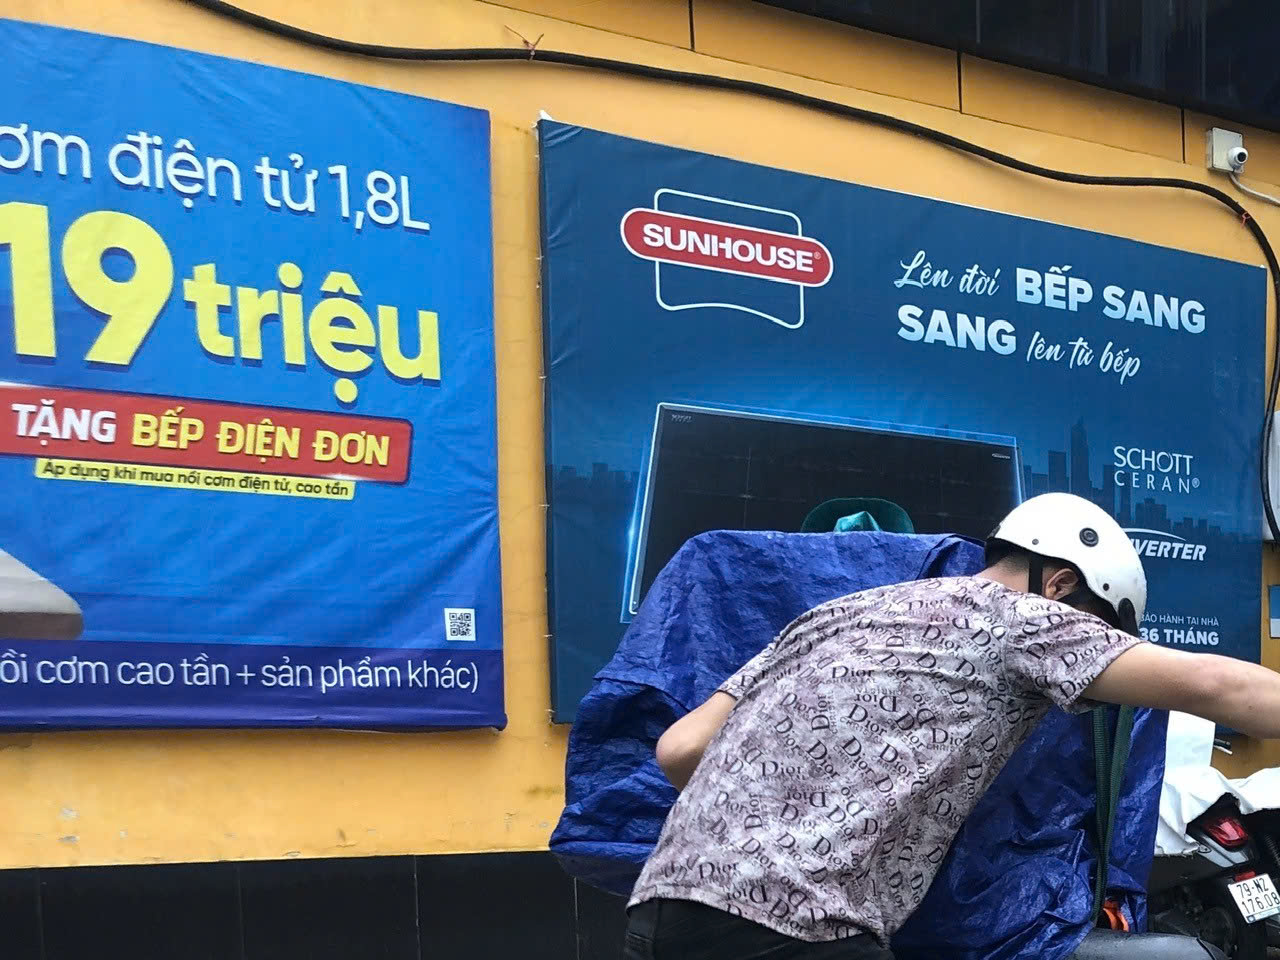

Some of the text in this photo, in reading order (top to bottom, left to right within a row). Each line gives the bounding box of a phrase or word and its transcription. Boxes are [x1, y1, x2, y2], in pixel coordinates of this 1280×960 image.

[109, 131, 242, 209] điện
[255, 152, 318, 213] tử
[328, 164, 431, 231] 1,8L
[642, 222, 814, 273] SUNHOUSE
[0, 201, 441, 404] 19 triệu
[894, 250, 1206, 334] Lên đời BẾP SANG
[897, 304, 1017, 355] SANG
[1026, 331, 1065, 362] lên
[1099, 341, 1142, 385] bếp
[11, 398, 390, 466] TẶNG BẾP ĐIỆN ĐƠN
[1113, 446, 1193, 475] SCHOTT
[69, 463, 110, 482] dụng
[114, 464, 136, 479] khi
[140, 470, 174, 483] mua
[239, 475, 270, 493] điện
[296, 482, 322, 495] cao
[1132, 538, 1207, 562] VERTER
[1139, 626, 1220, 646] 36 THÁNG
[1159, 612, 1184, 625] HÀNH
[1200, 614, 1220, 627] NHÀ
[36, 656, 109, 686] cơm
[117, 660, 174, 686] cao
[181, 652, 230, 688] tần
[261, 656, 313, 688] sản
[320, 654, 401, 695] phẩm
[407, 658, 480, 694] khác)
[1060, 644, 1098, 669] Dior
[847, 704, 888, 736] Dior
[841, 736, 876, 776] Dior
[1241, 891, 1280, 914] 176.08
